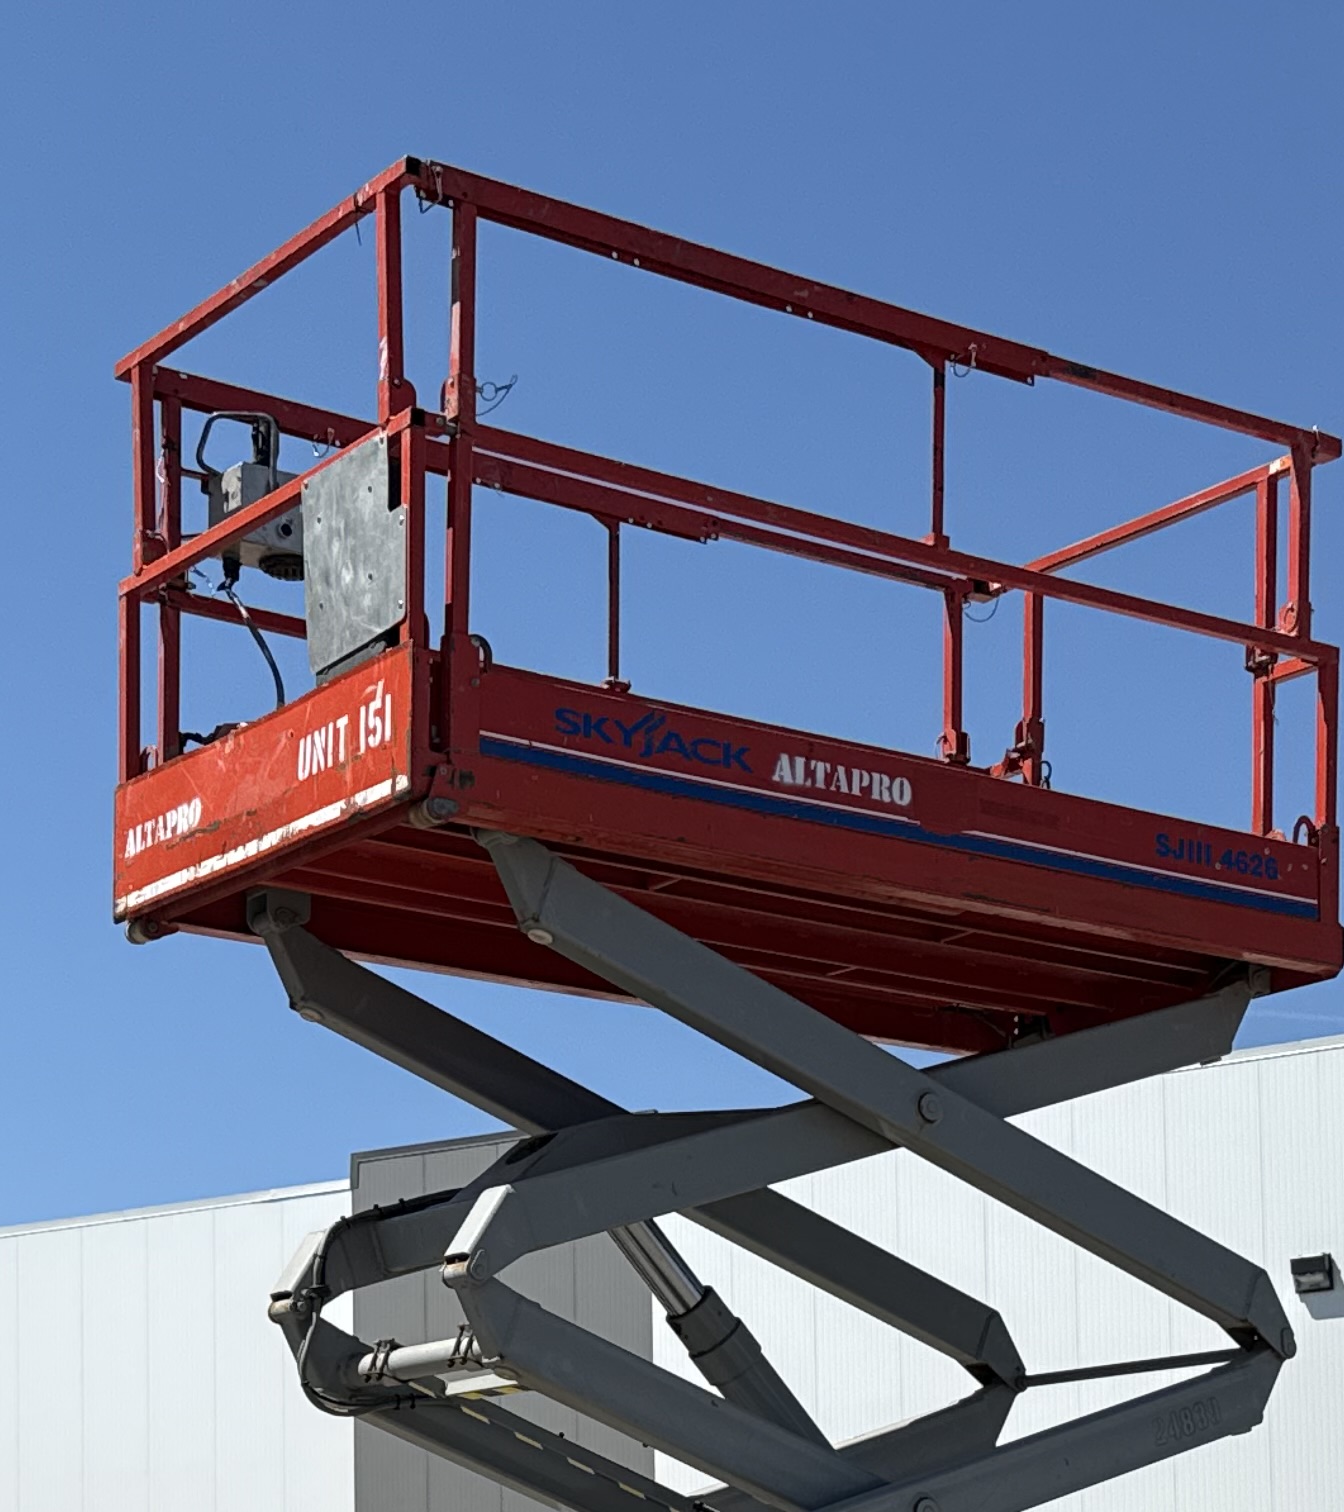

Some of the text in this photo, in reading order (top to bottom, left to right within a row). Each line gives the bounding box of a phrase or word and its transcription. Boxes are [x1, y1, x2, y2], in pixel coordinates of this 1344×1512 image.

[297, 692, 392, 781] UNIT 151
[555, 707, 912, 806] SKYJACK ALTAPRO
[124, 797, 203, 859] ALTAPRO
[1156, 833, 1279, 880] SJIII 4626
